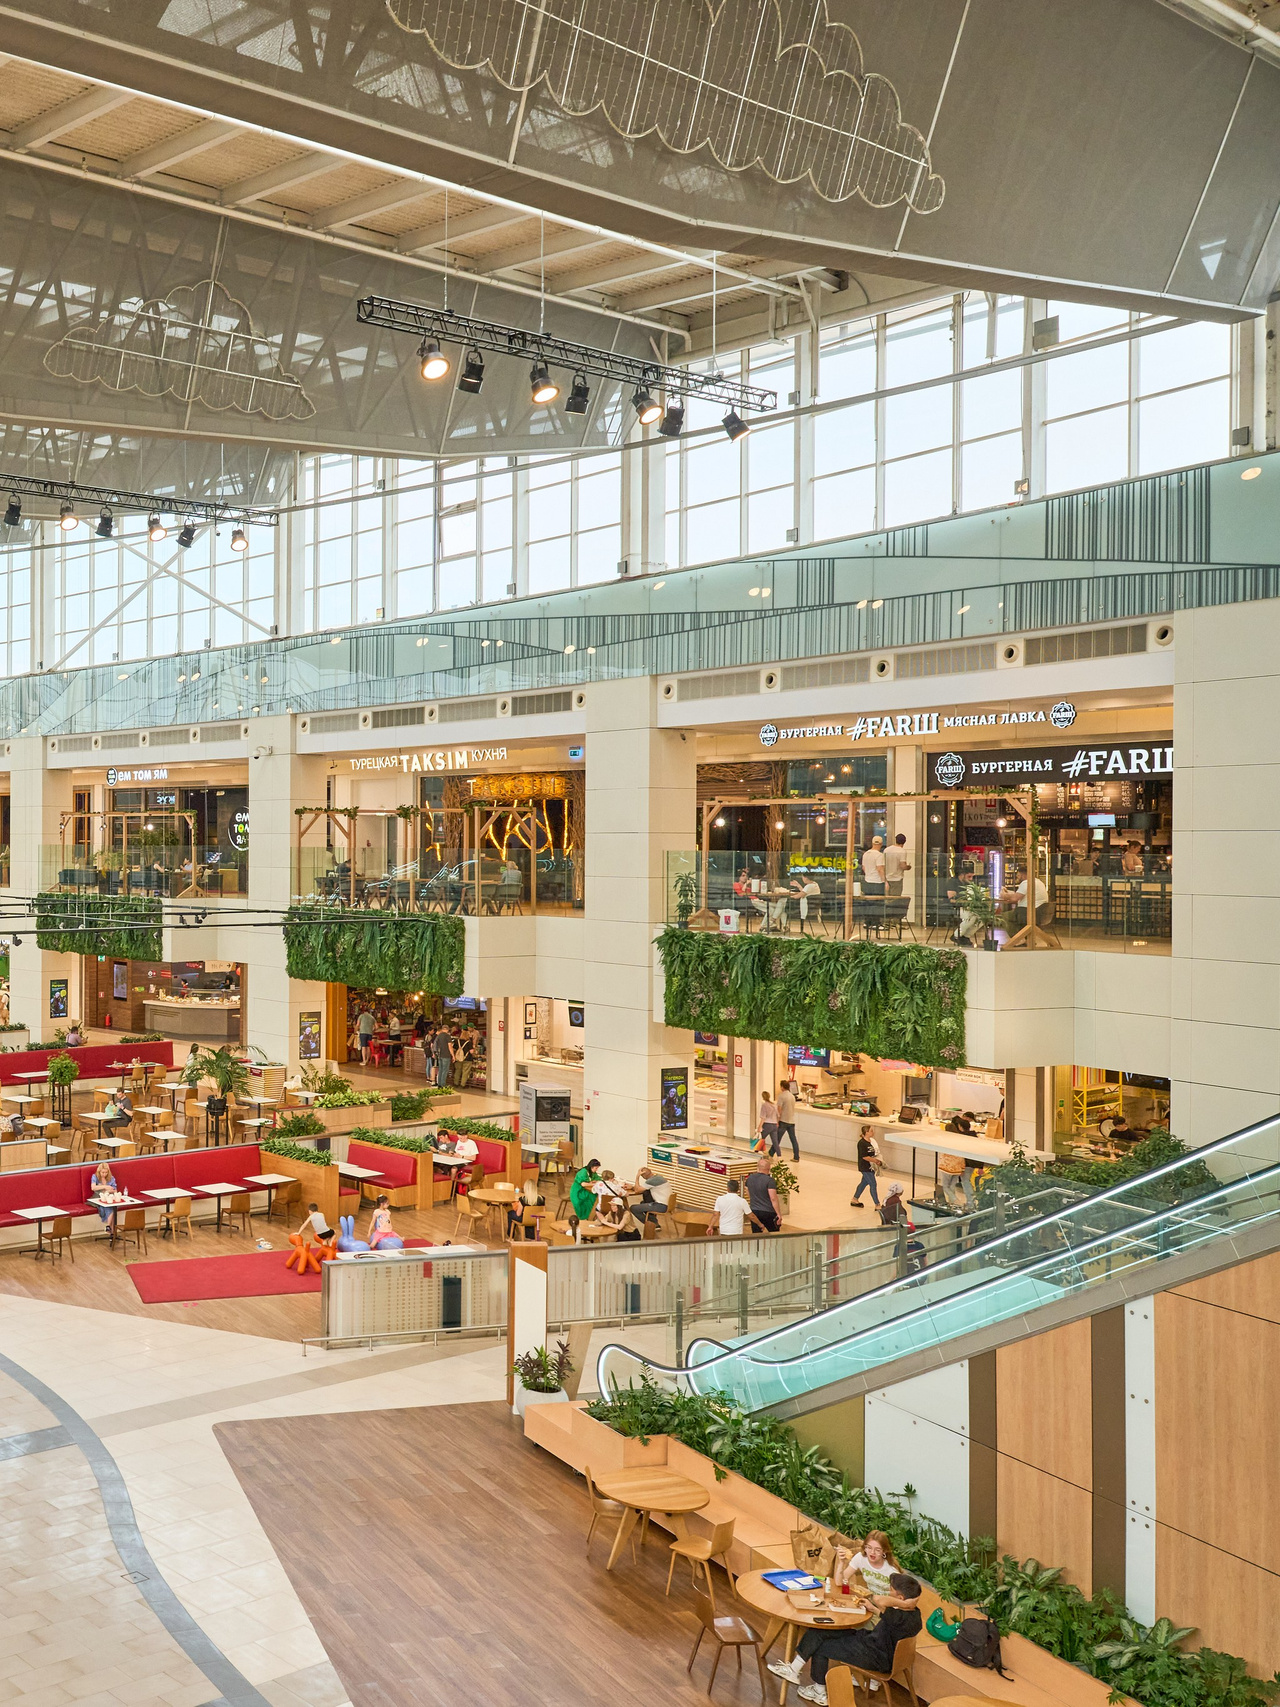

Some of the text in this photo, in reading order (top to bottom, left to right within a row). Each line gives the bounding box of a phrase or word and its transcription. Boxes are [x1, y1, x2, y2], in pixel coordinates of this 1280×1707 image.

[780, 726, 843, 740] БУРГЕРНАЯ
[943, 714, 996, 728] МЯСНАЯ
[1000, 710, 1046, 724] ЛАВКА
[349, 747, 508, 773] ТУРЕЦКАЯ TAKSIM КУХНЯ
[972, 759, 1053, 774] БУРГЕРНАЯ
